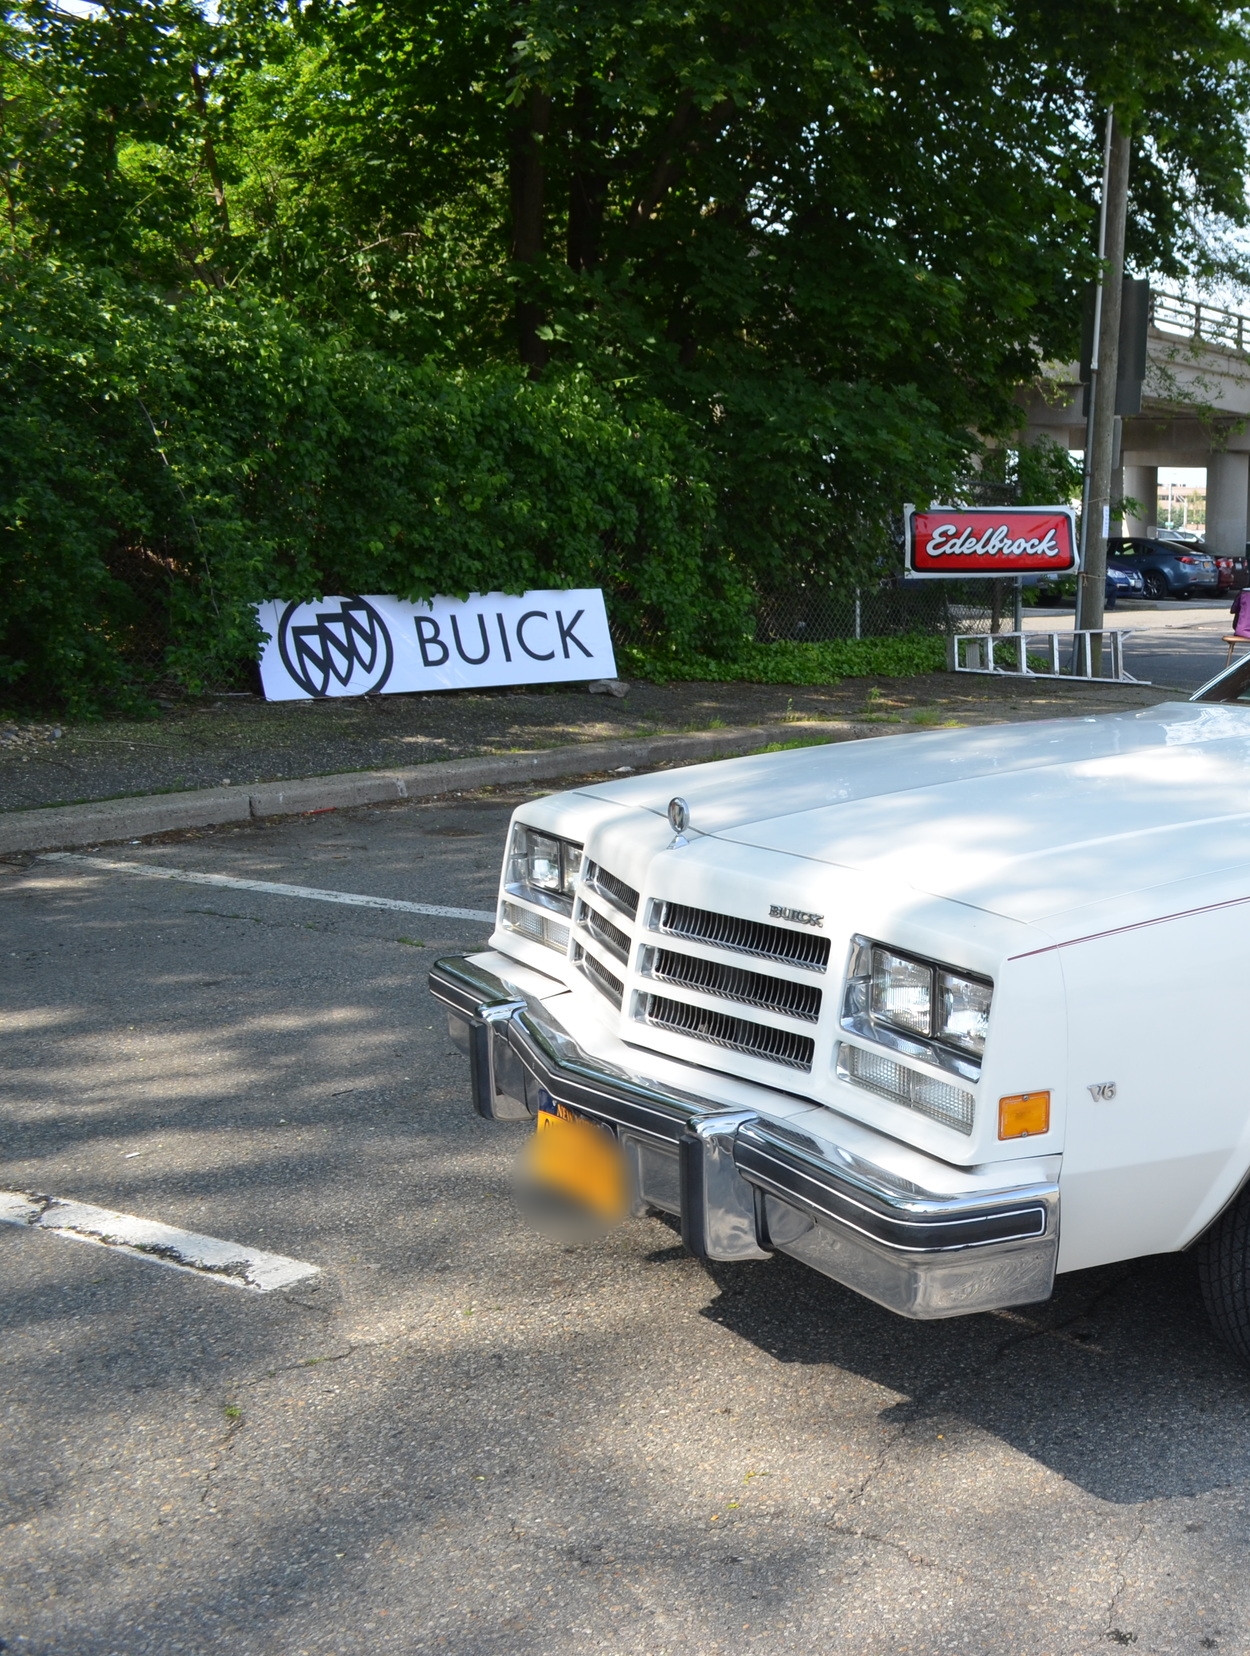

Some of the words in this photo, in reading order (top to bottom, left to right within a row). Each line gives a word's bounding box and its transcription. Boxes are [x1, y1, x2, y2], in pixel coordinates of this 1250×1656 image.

[926, 524, 1059, 558] Edelbrock
[414, 609, 594, 667] BUICK
[768, 904, 824, 928] BUICK
[1087, 1081, 1117, 1102] V6
